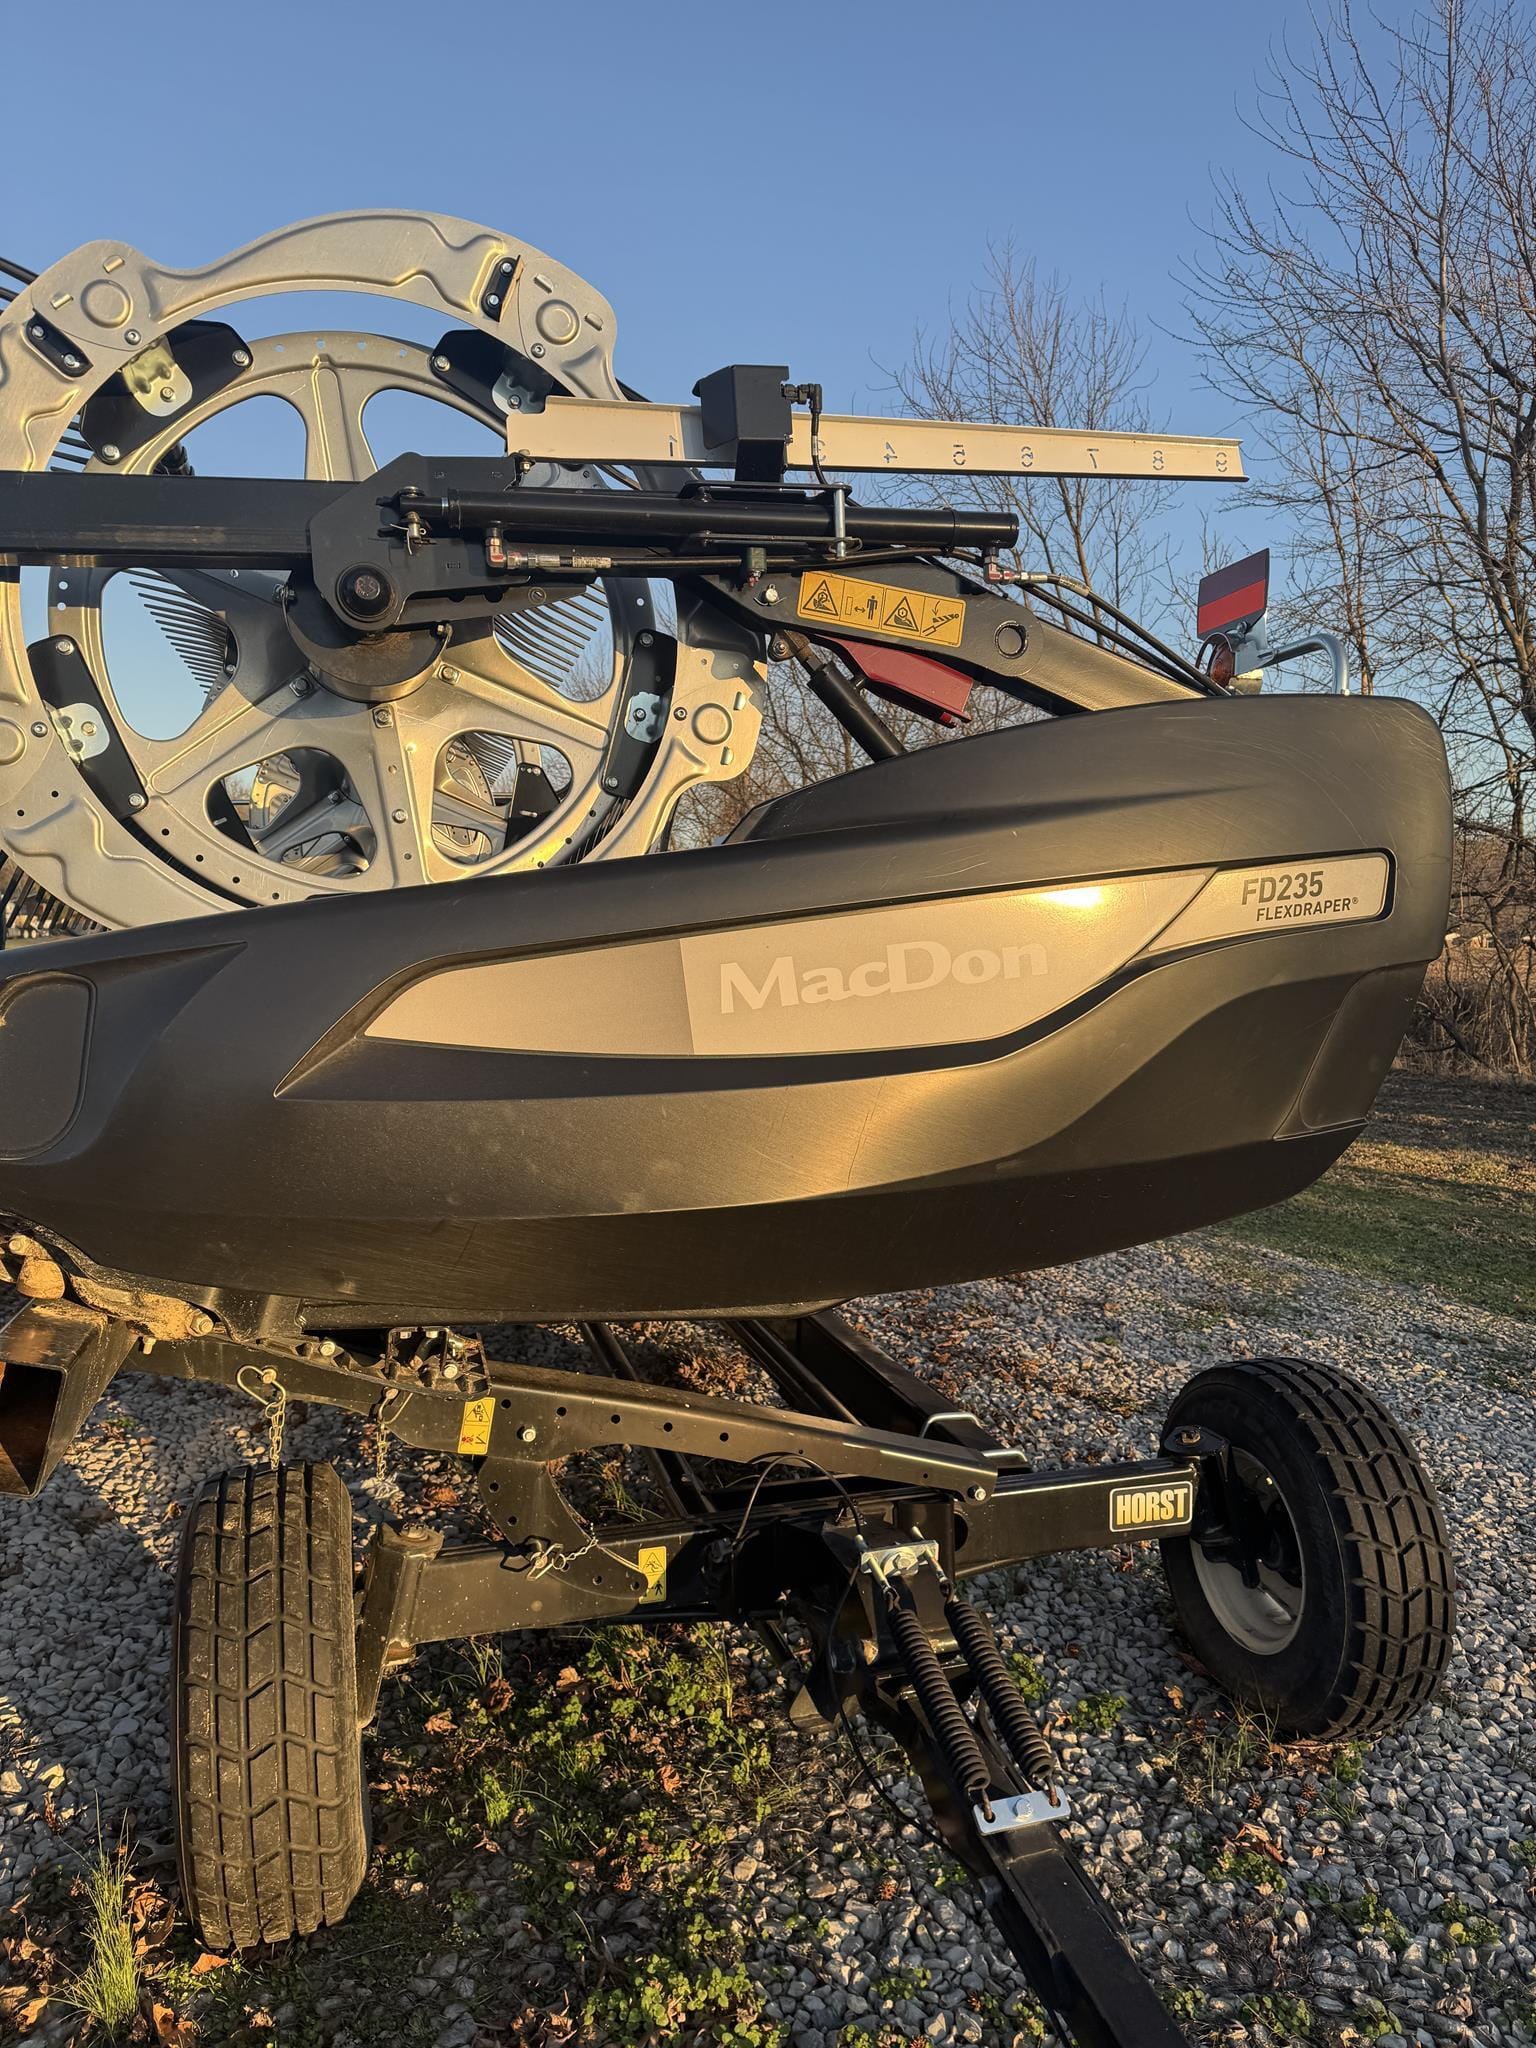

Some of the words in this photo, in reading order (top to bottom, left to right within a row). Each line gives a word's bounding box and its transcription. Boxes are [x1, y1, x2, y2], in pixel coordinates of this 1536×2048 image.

[1241, 870, 1324, 905] FD235
[720, 940, 1049, 1015] MacDon
[1116, 1487, 1188, 1526] HORST
